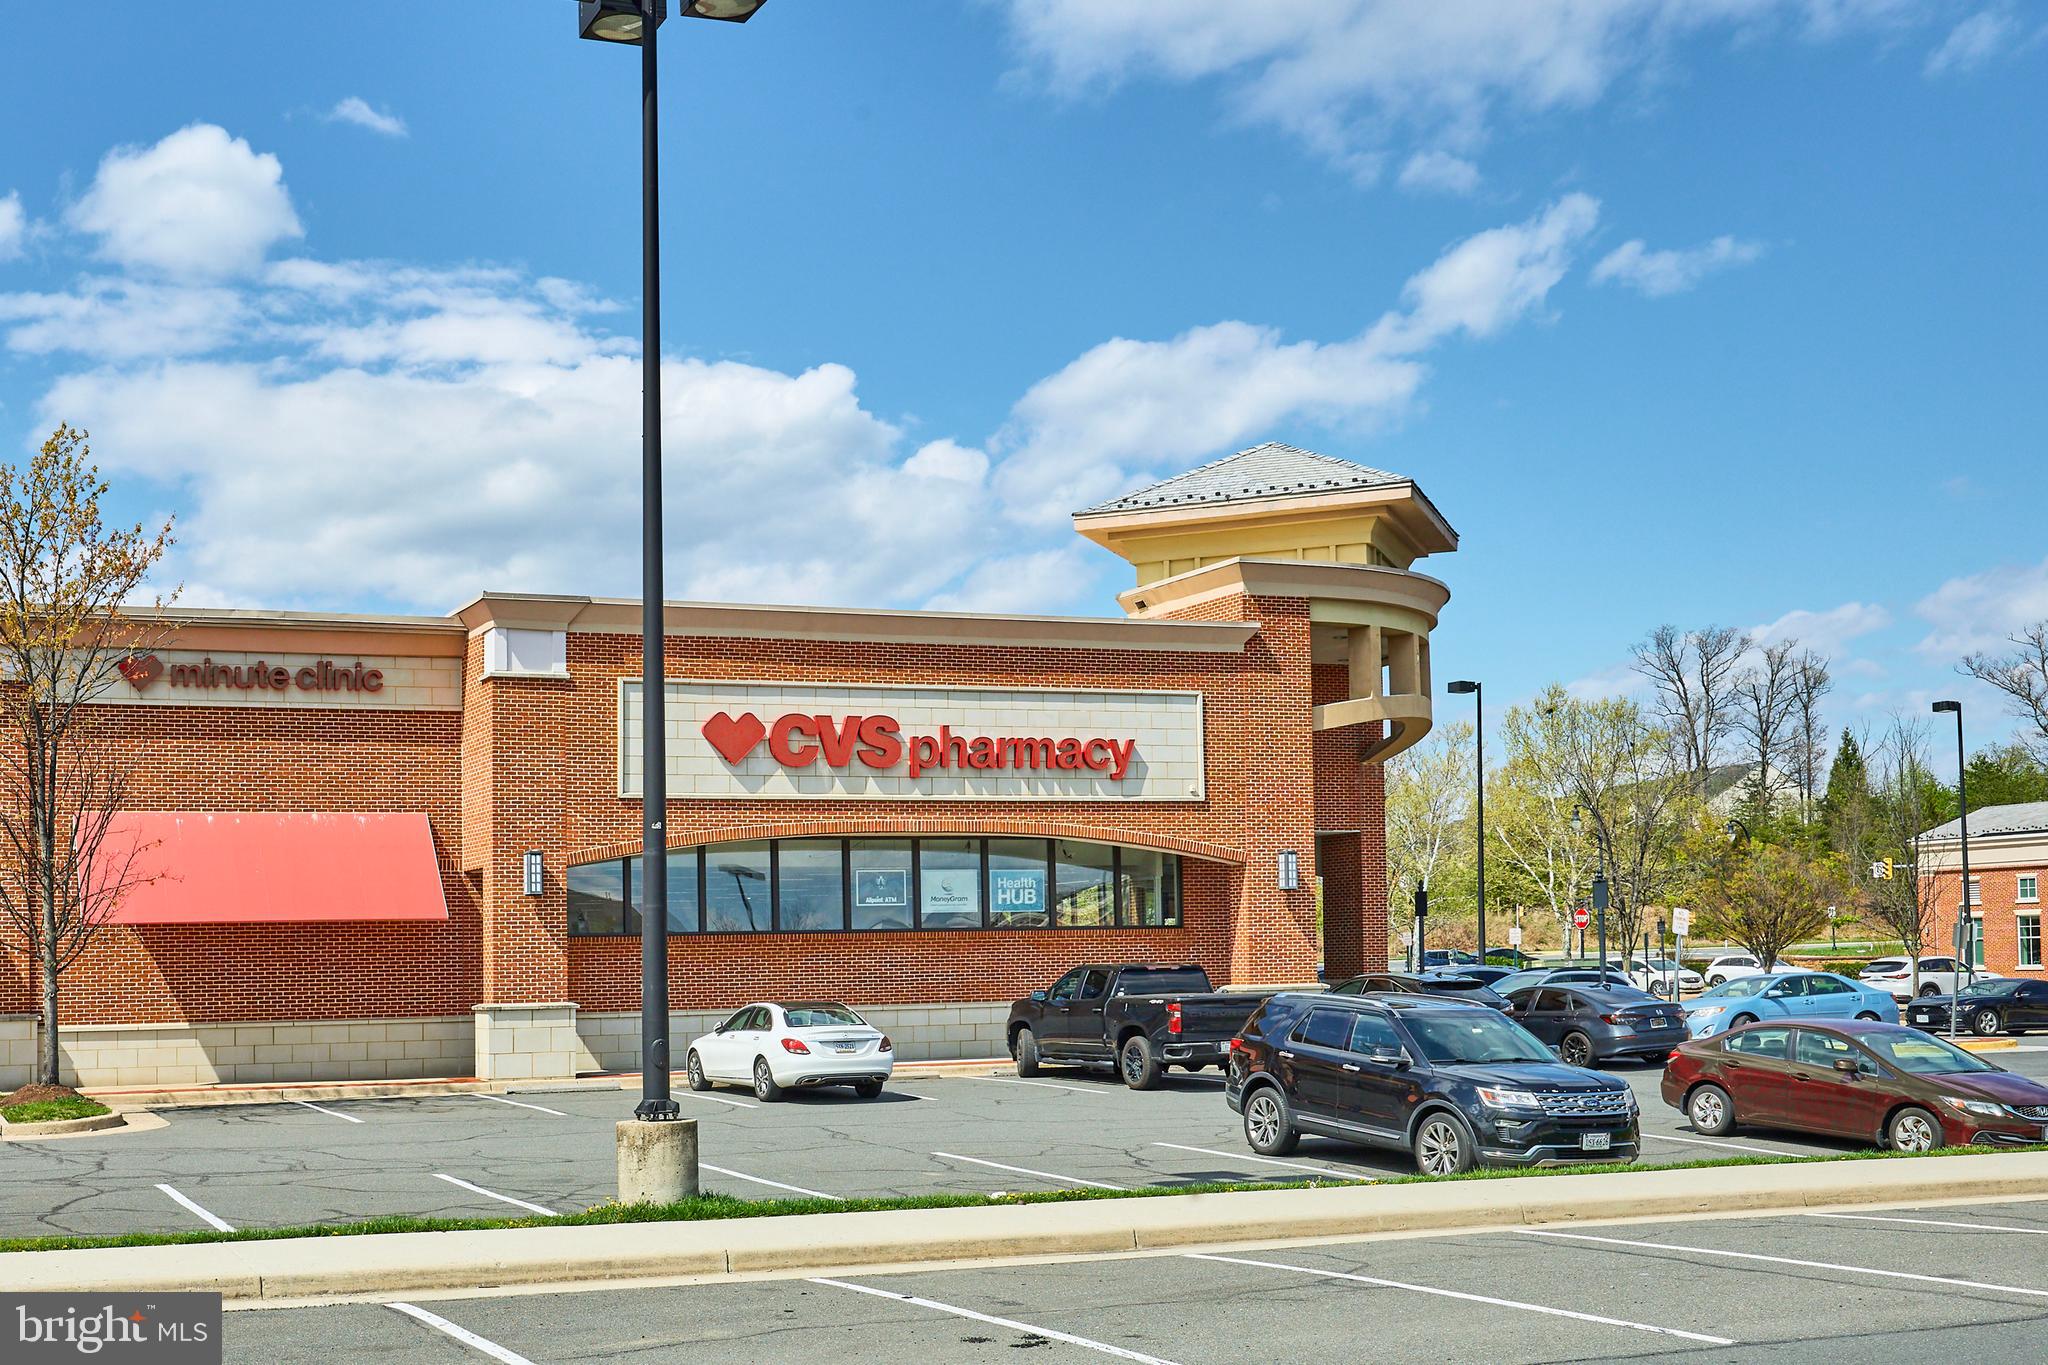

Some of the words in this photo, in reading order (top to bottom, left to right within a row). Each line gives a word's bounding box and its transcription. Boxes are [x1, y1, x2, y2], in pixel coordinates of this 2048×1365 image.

[170, 657, 290, 690] minute
[295, 660, 384, 692] clinic
[769, 713, 900, 768] CVS
[909, 725, 1136, 780] pharmacy
[997, 877, 1036, 888] Health
[997, 889, 1037, 904] HUB
